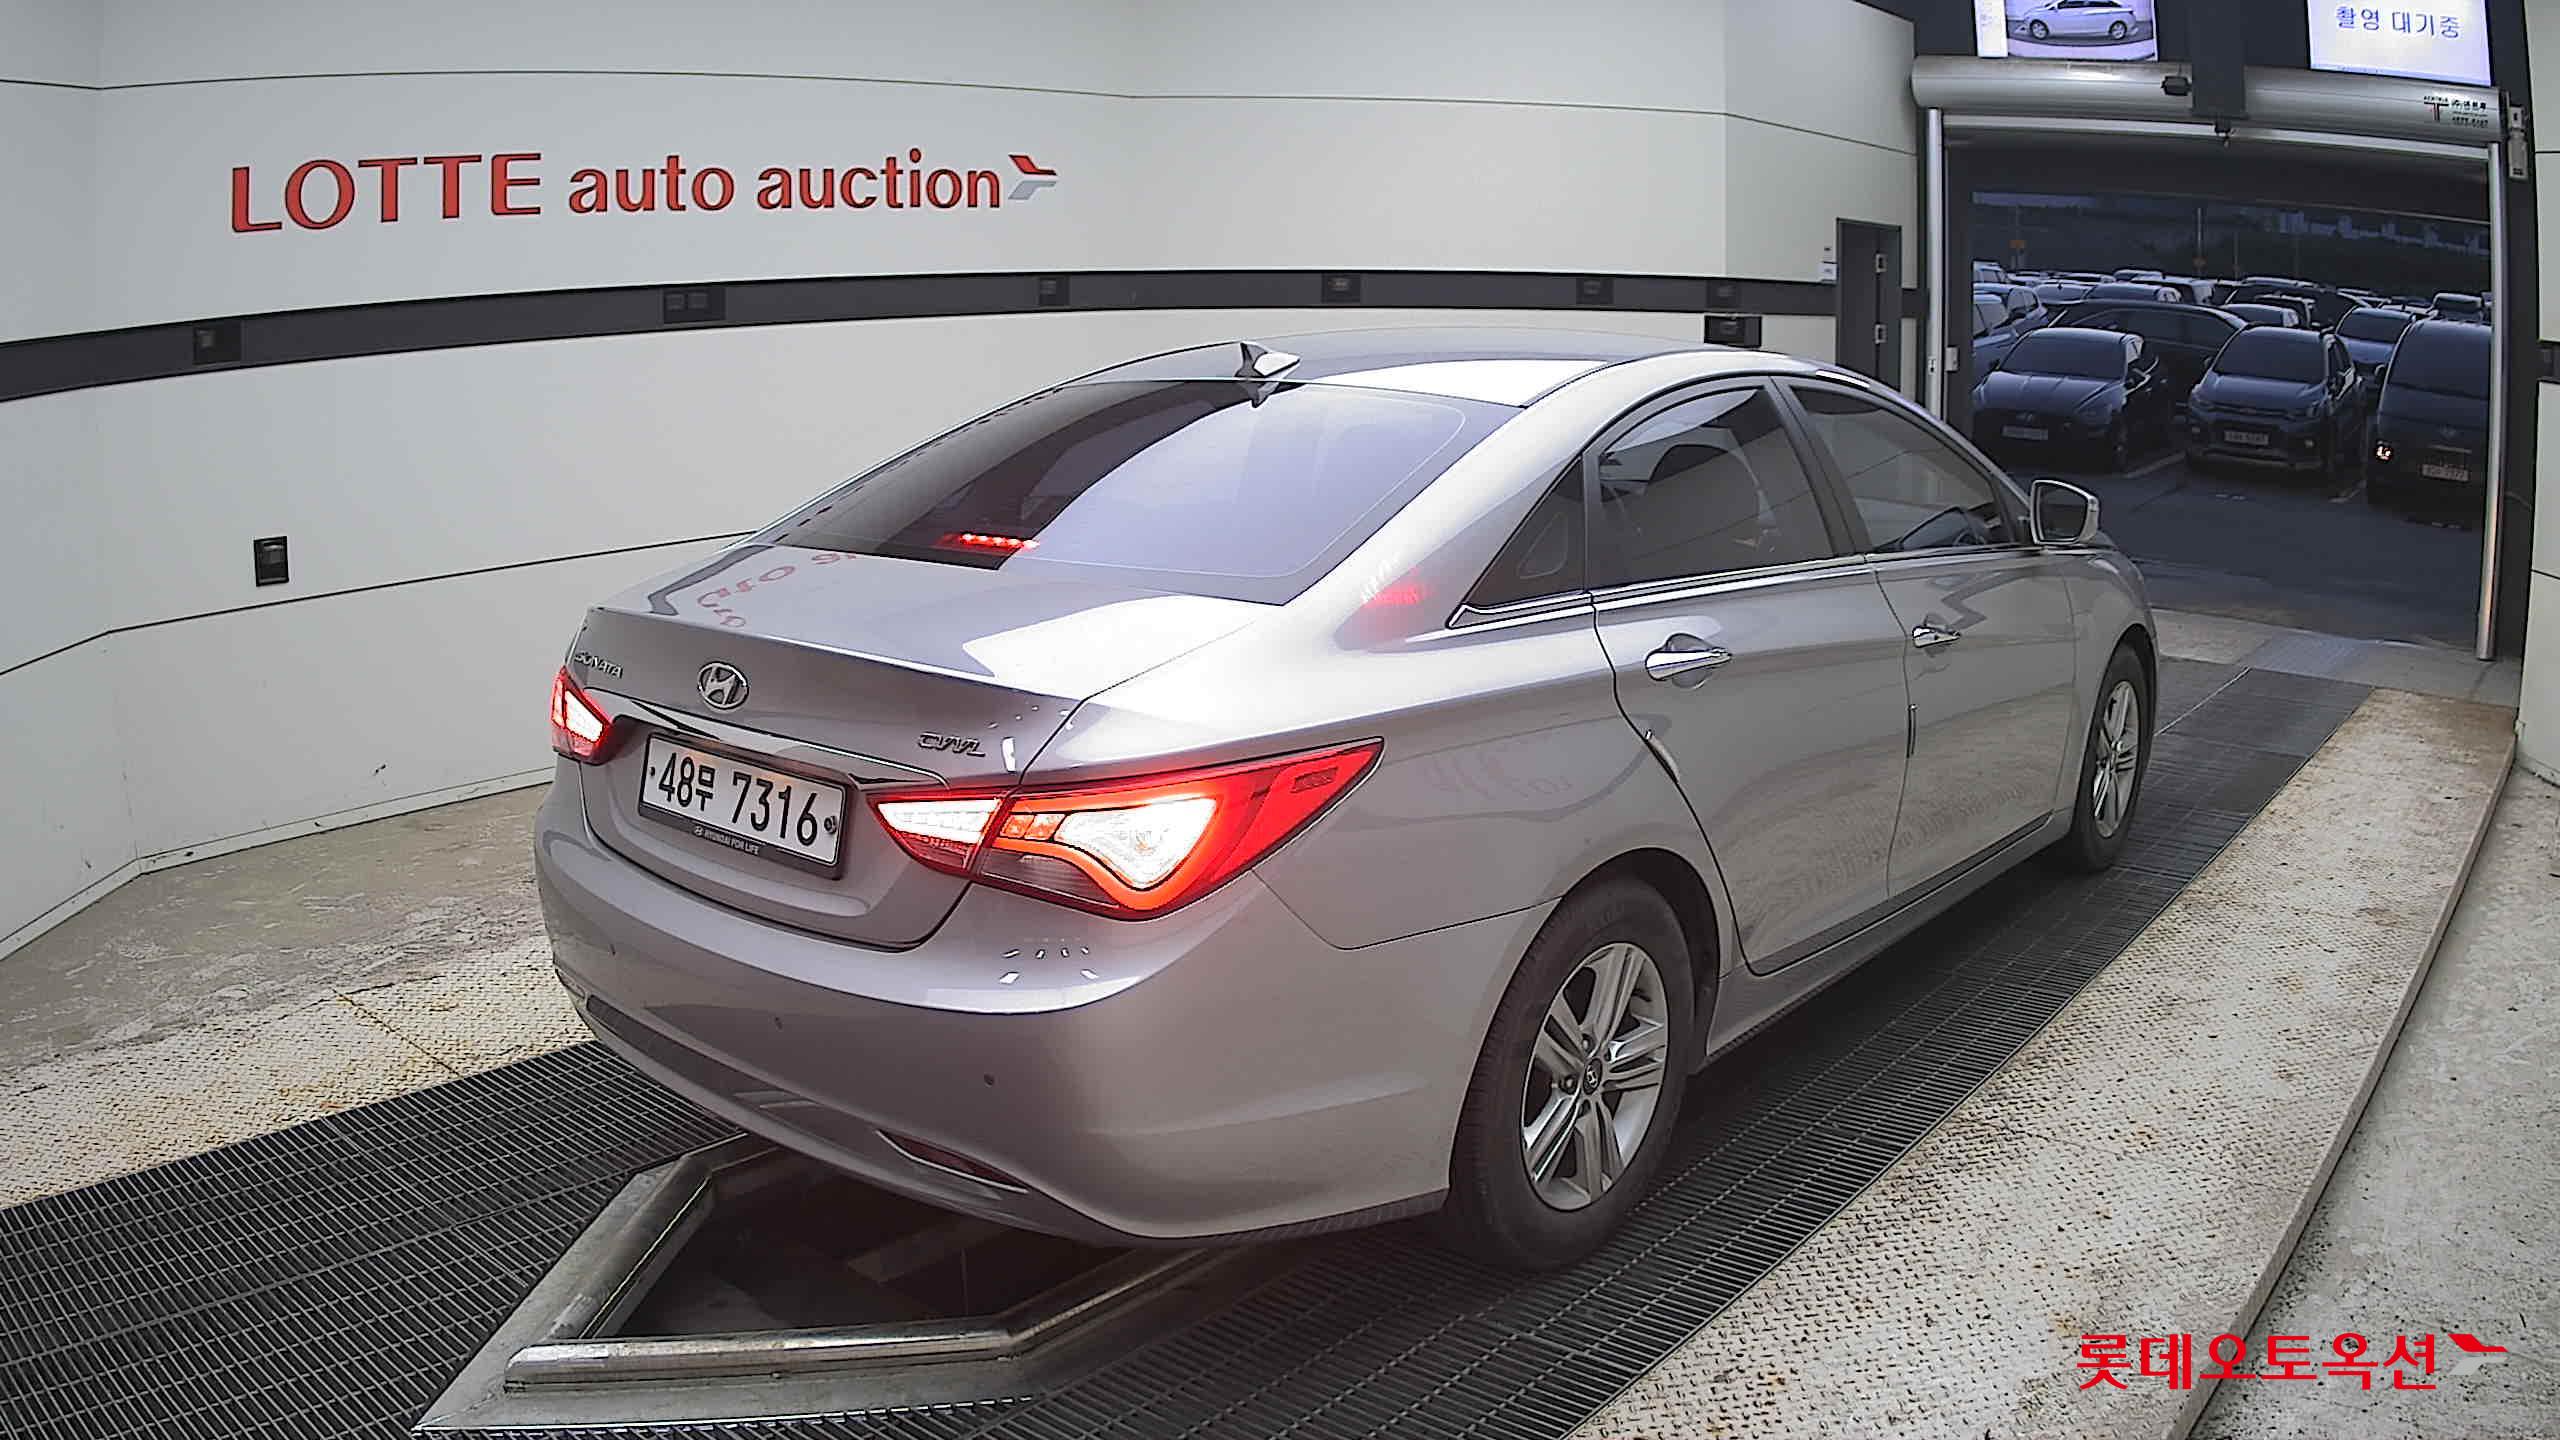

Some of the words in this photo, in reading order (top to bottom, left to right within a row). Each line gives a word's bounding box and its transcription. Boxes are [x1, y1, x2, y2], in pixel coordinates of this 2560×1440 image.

[2336, 5, 2381, 32] 촬영
[2391, 11, 2460, 39] 대기중
[231, 153, 542, 233] LOTTE
[568, 154, 735, 214] auto
[756, 147, 1002, 210] auction
[574, 652, 623, 679] SONATA
[658, 752, 716, 812] 48무
[732, 771, 818, 847] 7316
[731, 838, 745, 850] FOR
[745, 841, 759, 855] LIFE
